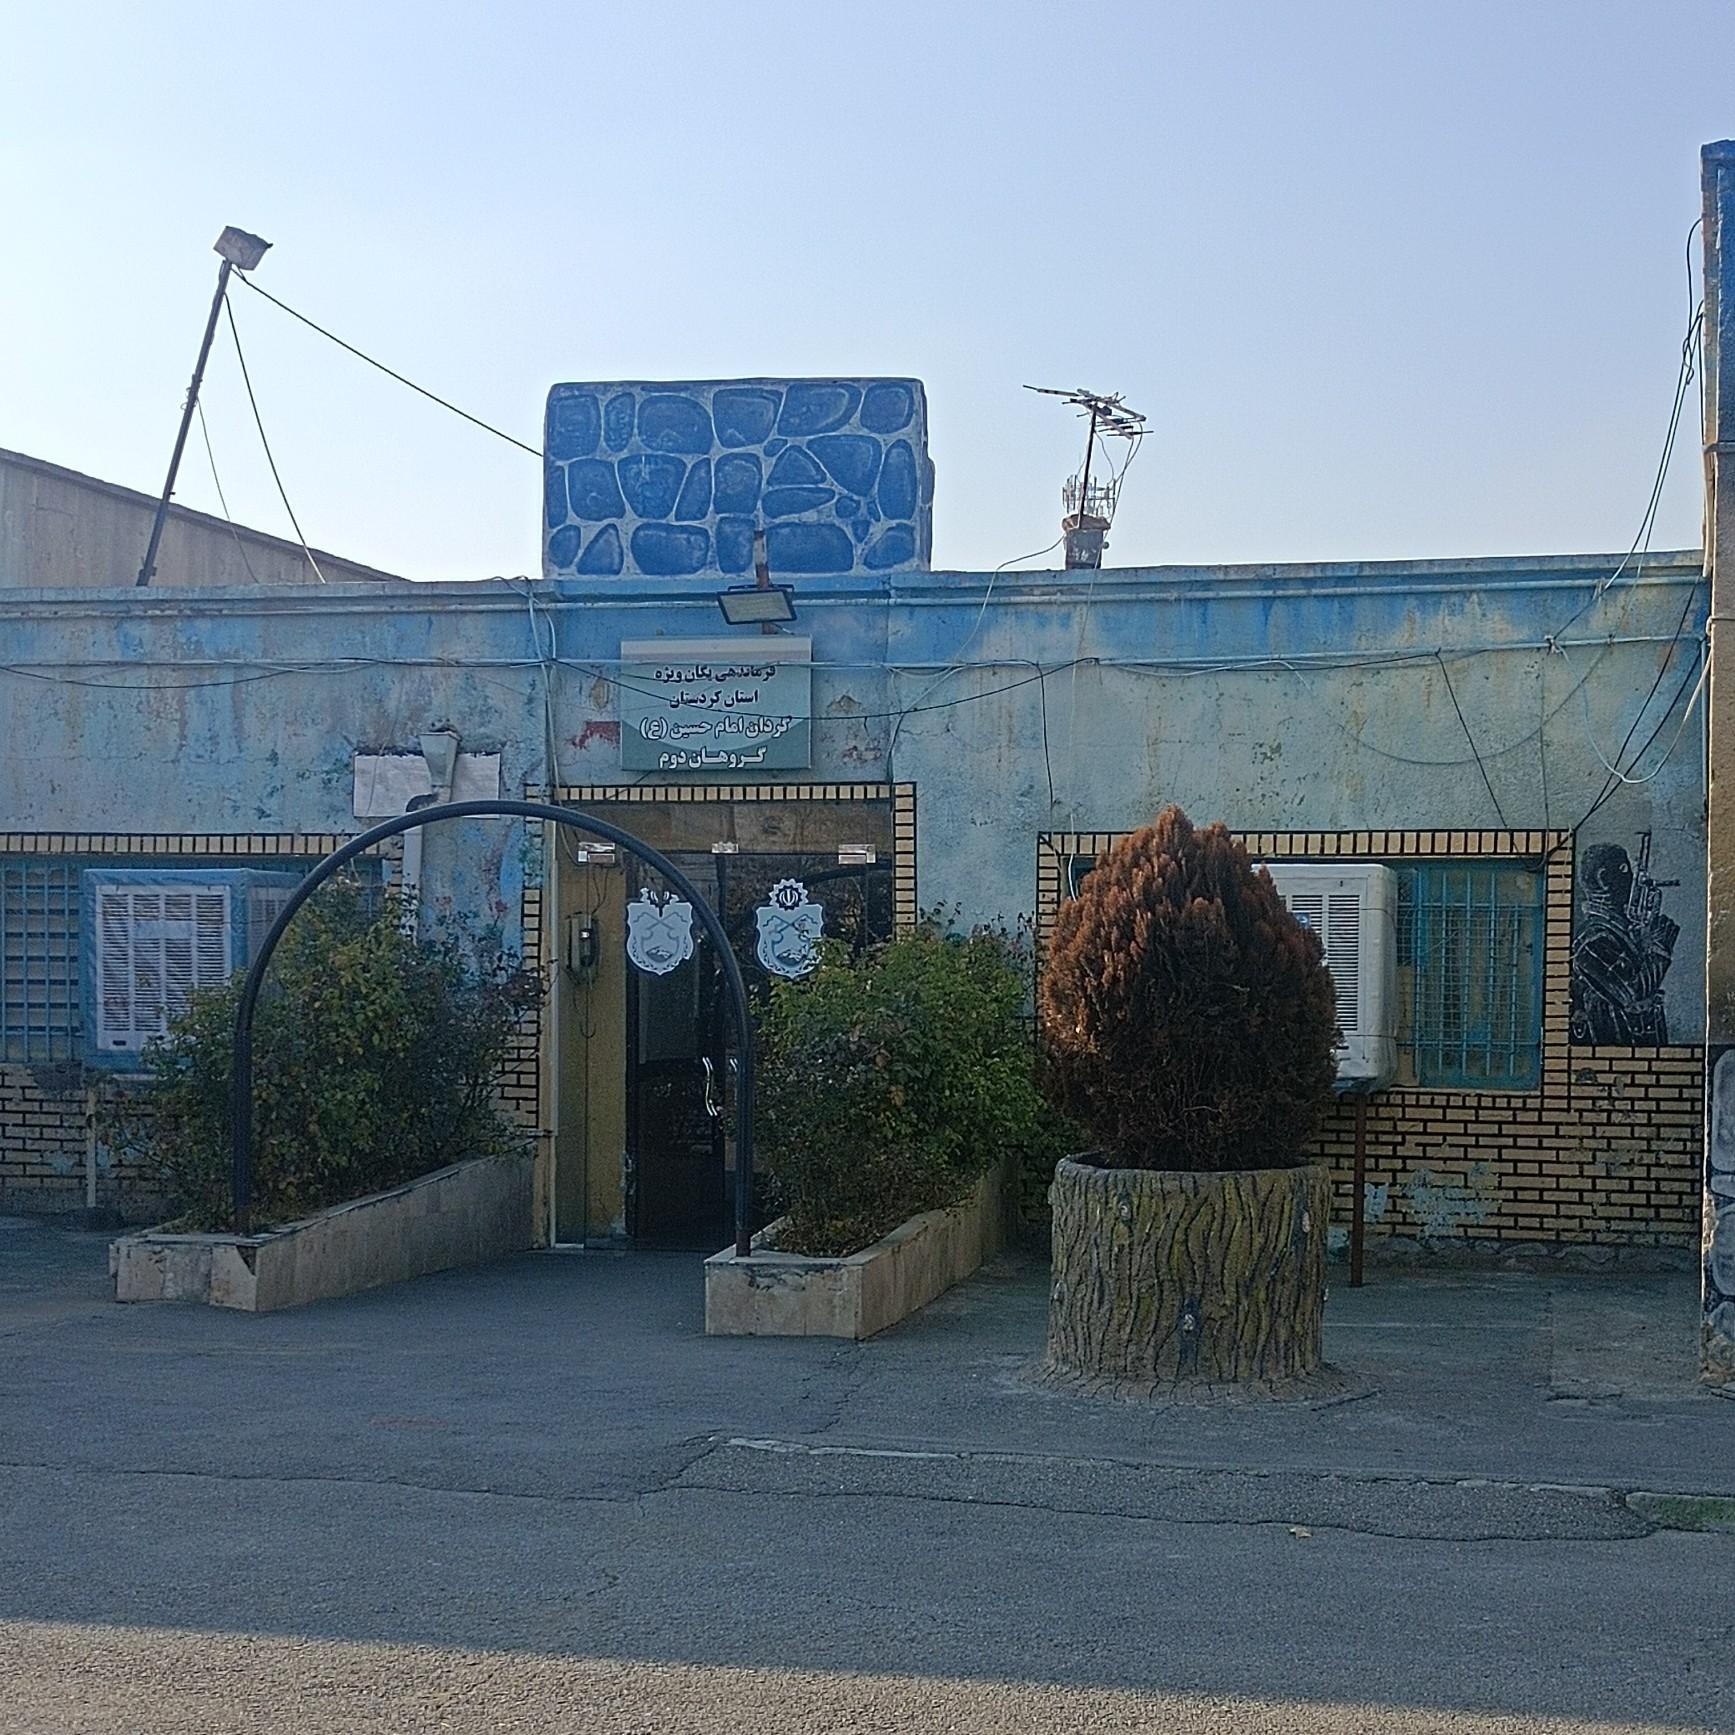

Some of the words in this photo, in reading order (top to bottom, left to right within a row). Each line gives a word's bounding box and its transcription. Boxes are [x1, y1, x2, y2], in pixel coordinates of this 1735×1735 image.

[655, 666, 683, 683] ویژه
[715, 665, 776, 682] فرماندهی
[669, 689, 722, 709] کردستان
[724, 689, 759, 708] استان
[639, 716, 669, 740] (ع)
[670, 720, 713, 739] حسین
[714, 715, 744, 739] امام
[745, 716, 791, 738] گردان
[659, 750, 687, 769] دوم
[688, 745, 768, 769] گروهان
